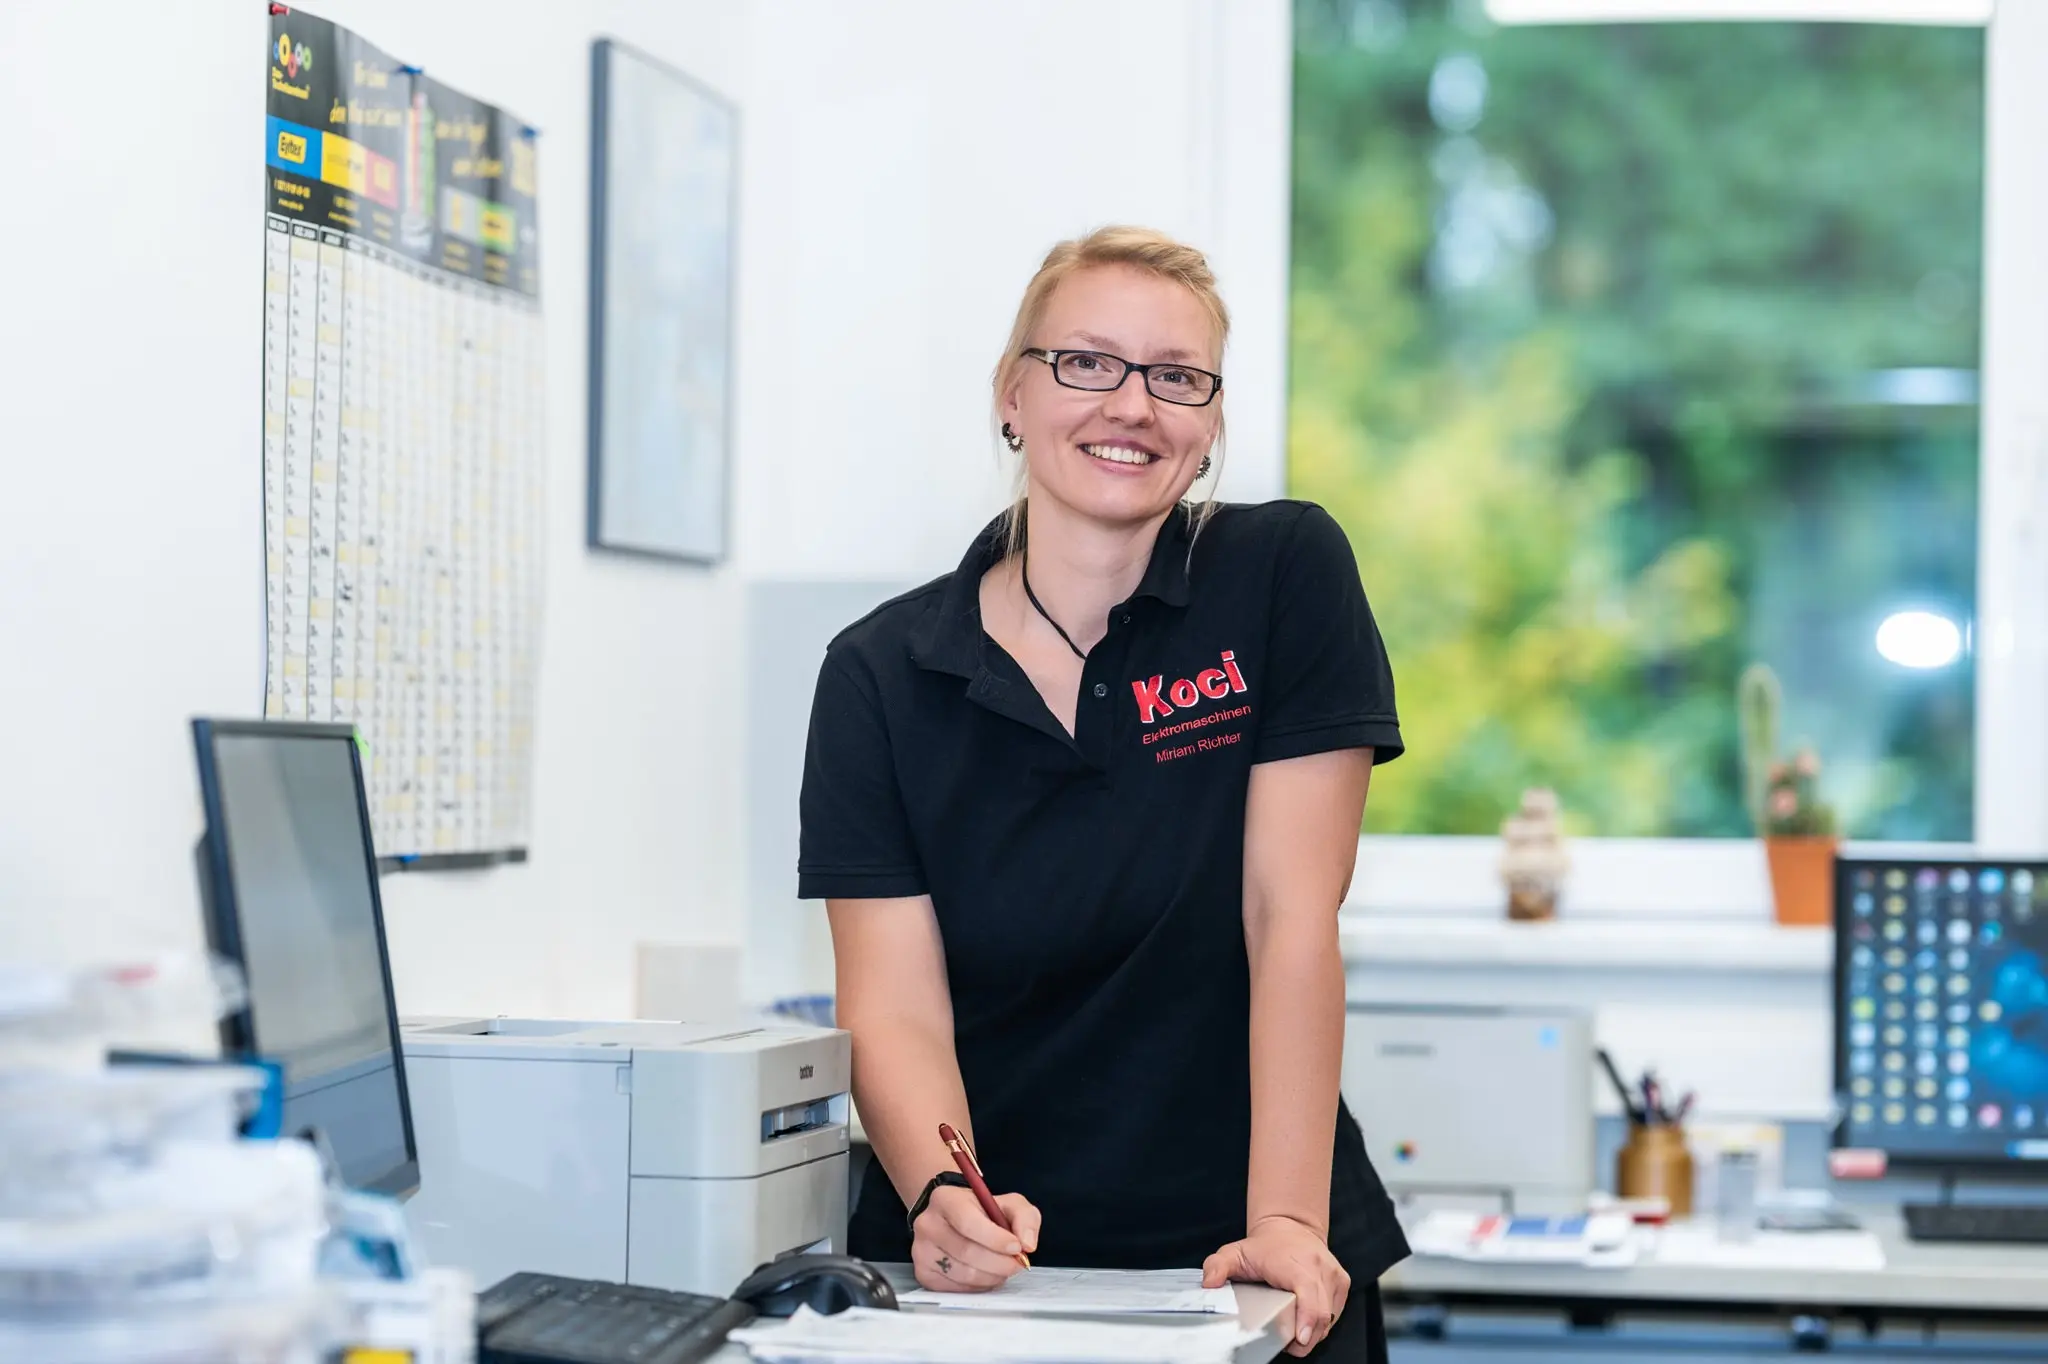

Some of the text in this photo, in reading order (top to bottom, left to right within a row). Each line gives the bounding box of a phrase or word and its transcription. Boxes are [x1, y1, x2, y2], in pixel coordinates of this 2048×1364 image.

[1131, 650, 1248, 724] Koci
[1142, 705, 1252, 745] Elektromaschinen
[1156, 732, 1241, 763] Miriam Richter
